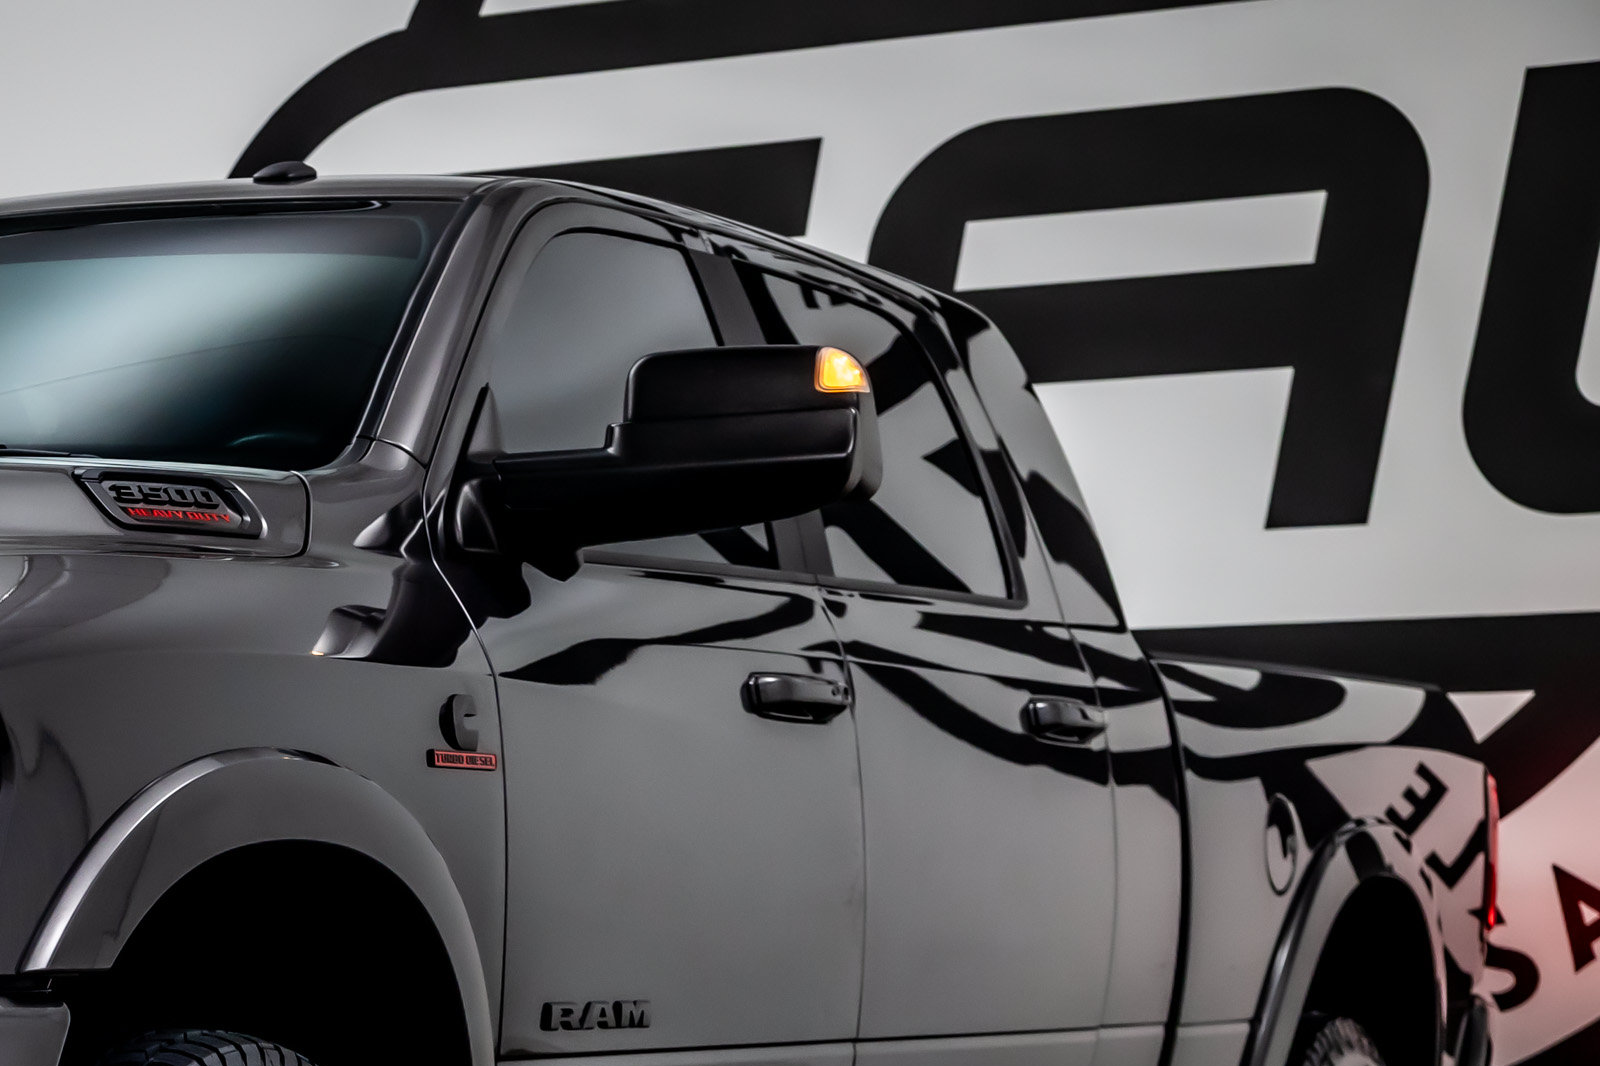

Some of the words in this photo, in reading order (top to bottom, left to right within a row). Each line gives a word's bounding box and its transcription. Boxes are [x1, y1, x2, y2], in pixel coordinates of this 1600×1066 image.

[109, 484, 219, 509] 3500
[126, 507, 183, 519] HEAVY
[186, 511, 231, 523] DUTY
[435, 752, 464, 765] TURBO
[465, 754, 495, 767] DIESEL
[540, 1000, 649, 1031] RAM
